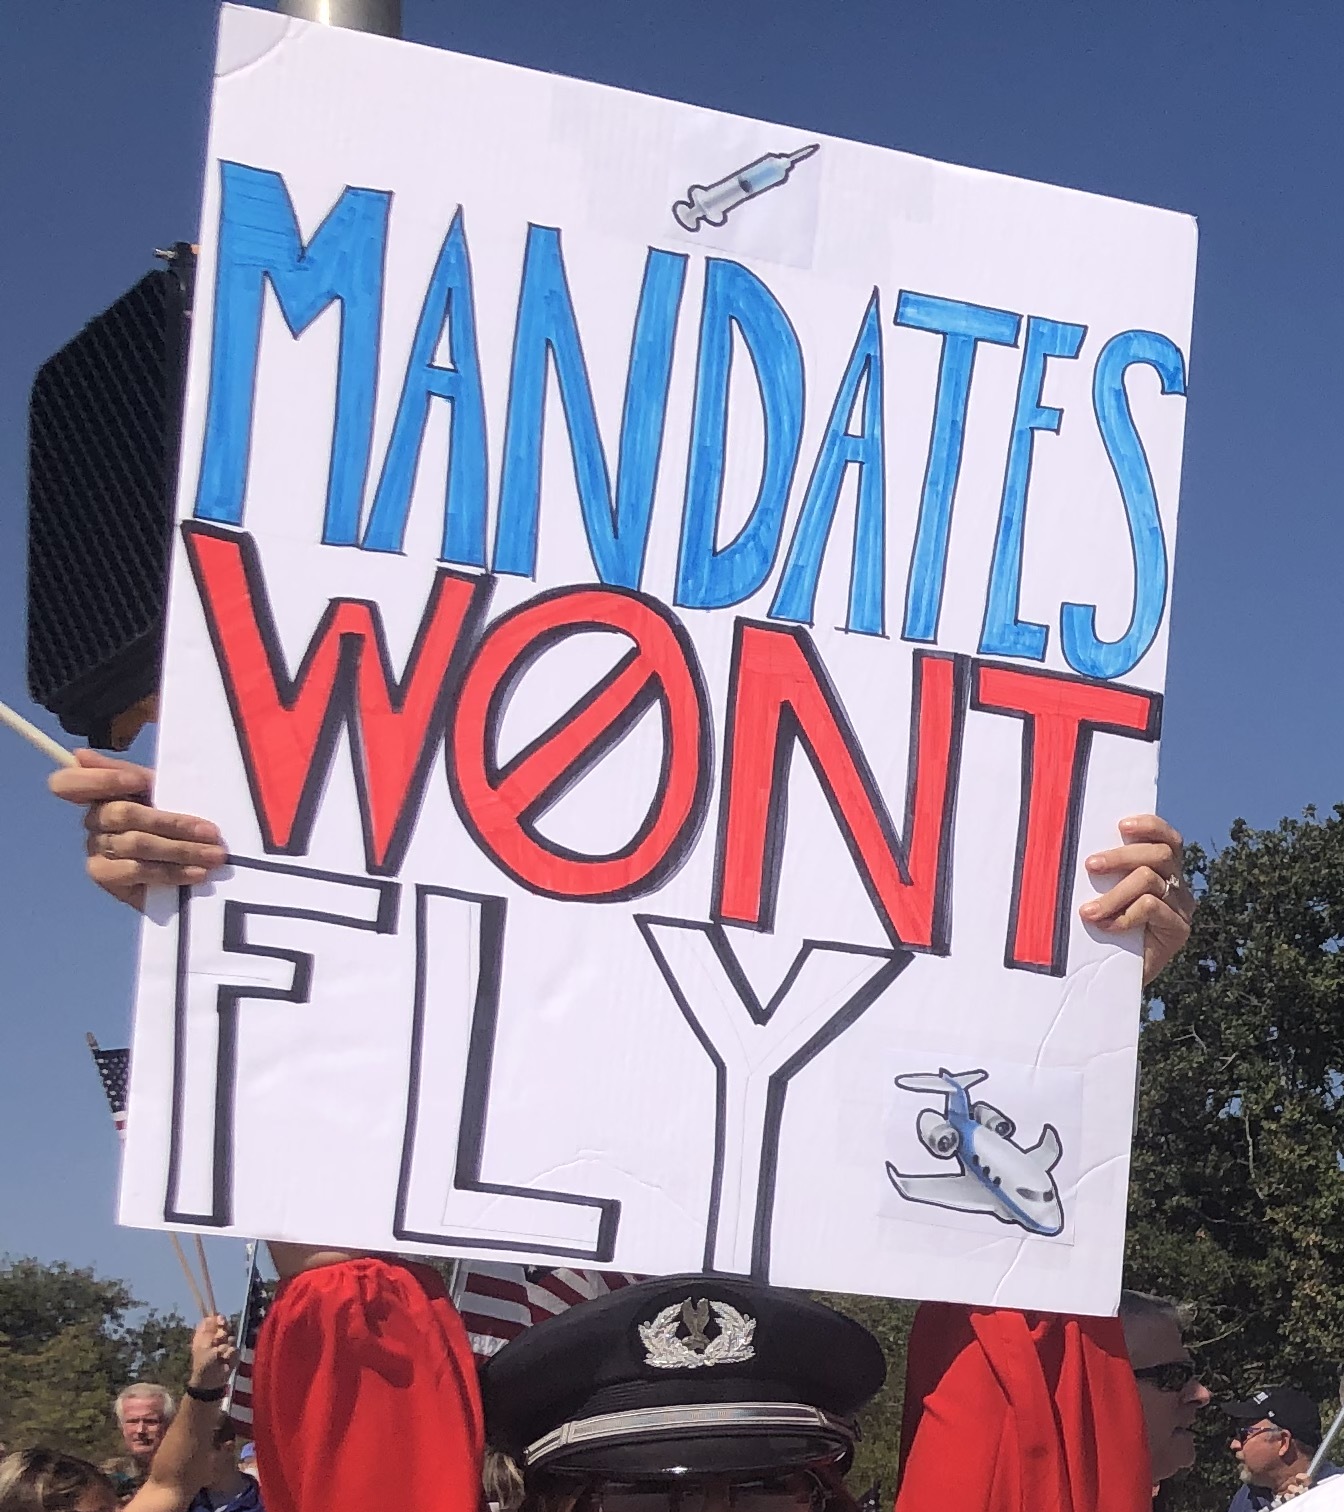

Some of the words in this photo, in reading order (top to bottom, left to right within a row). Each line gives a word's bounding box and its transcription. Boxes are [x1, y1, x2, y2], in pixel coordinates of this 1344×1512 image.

[194, 160, 1190, 681] MANDATES
[183, 518, 1164, 978] WONT
[164, 856, 914, 1285] FLY
